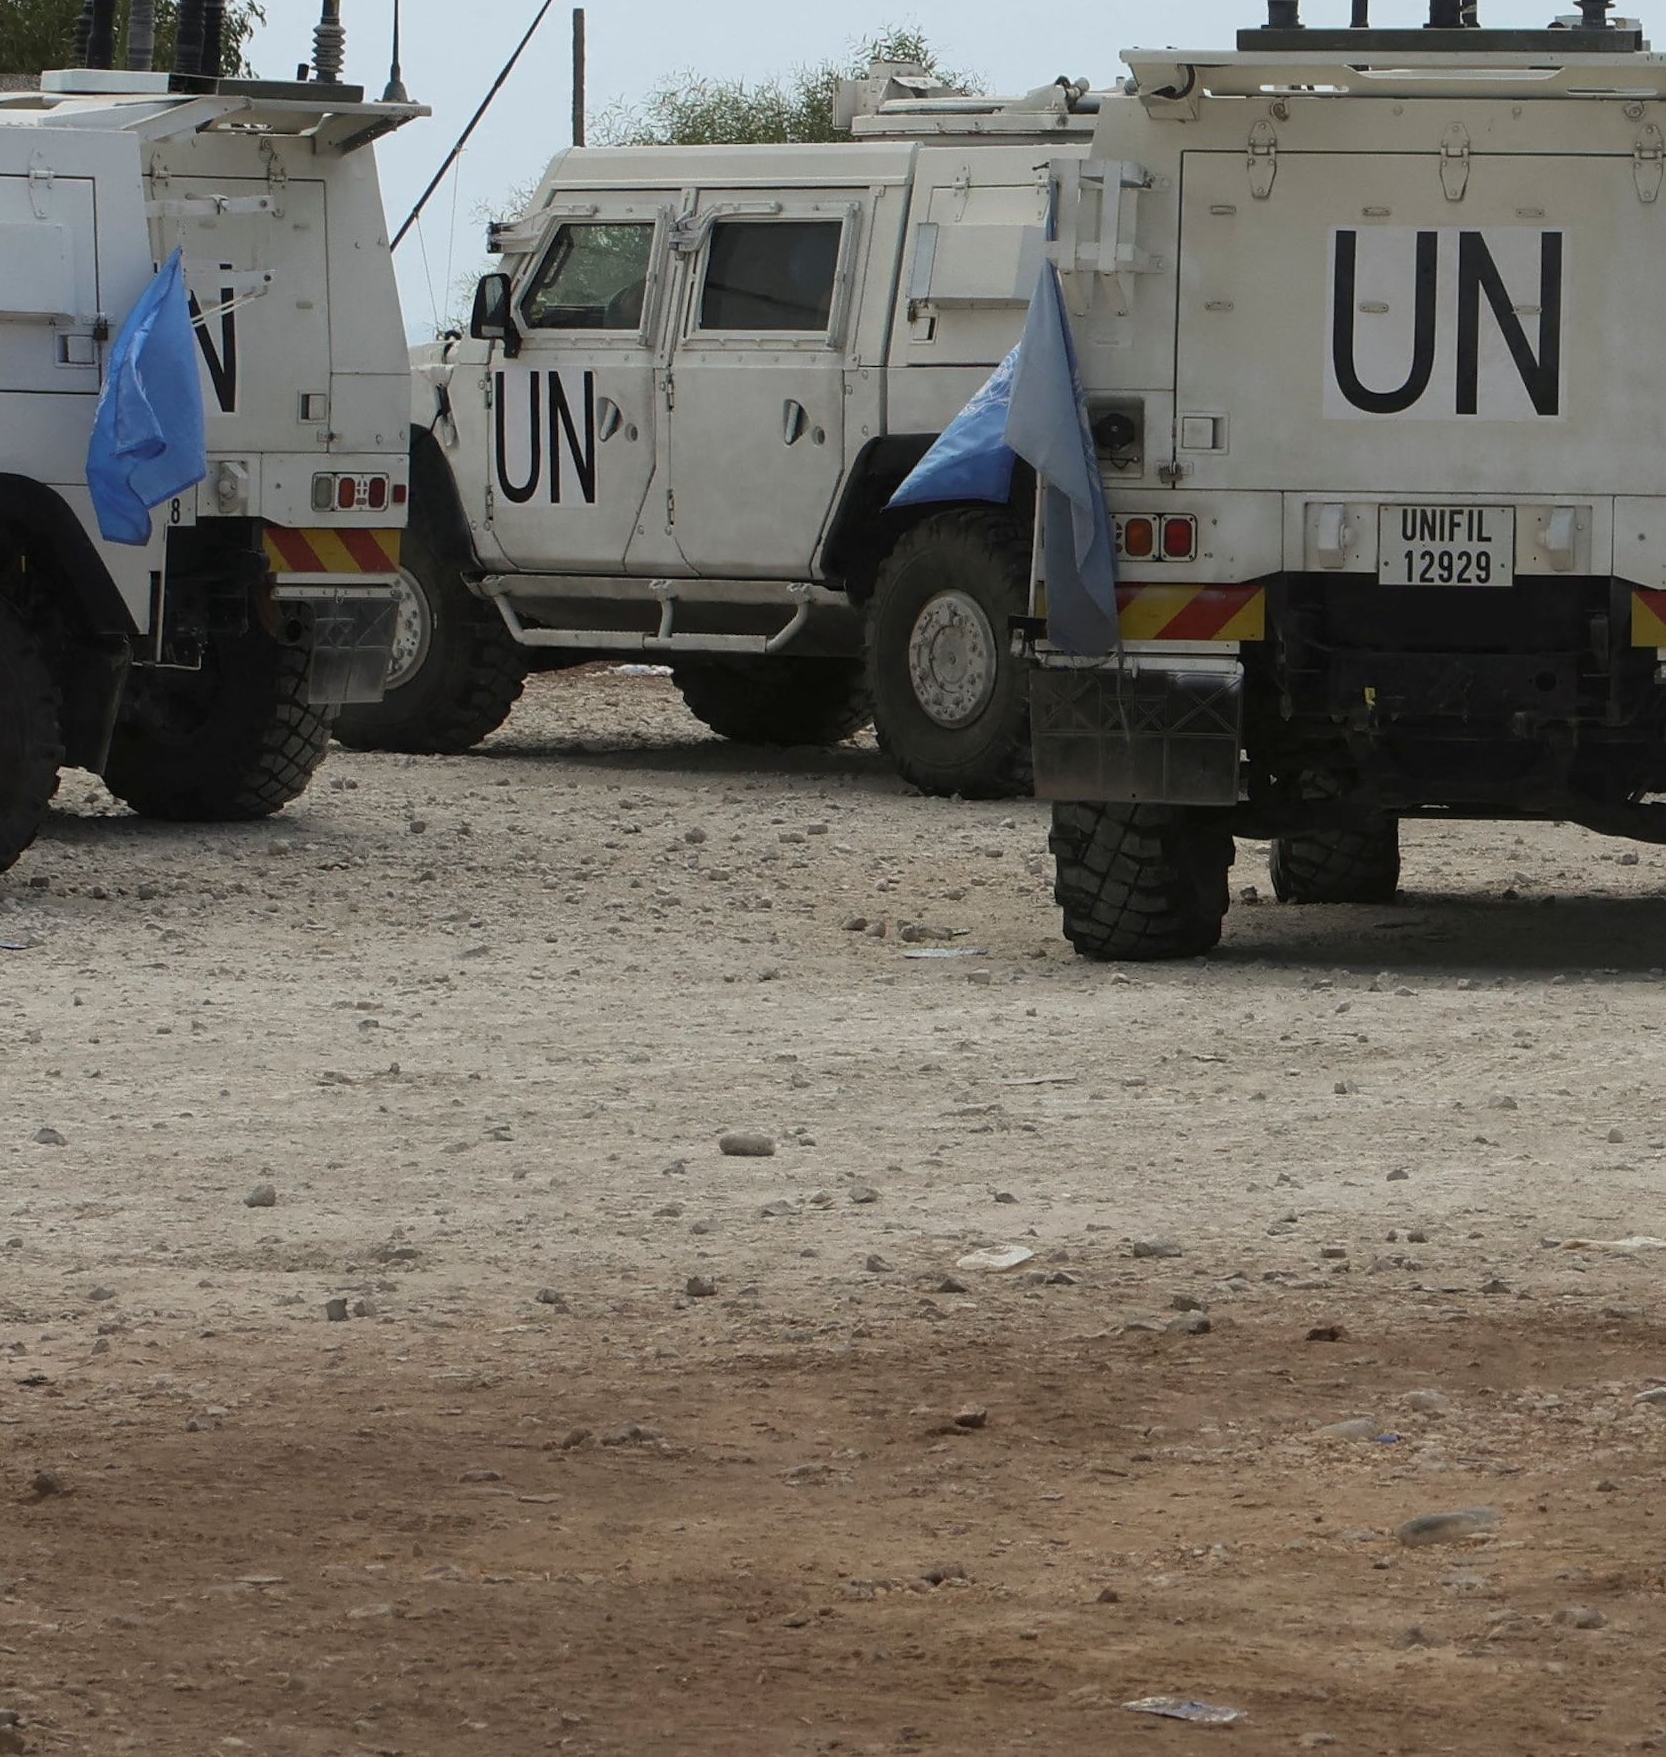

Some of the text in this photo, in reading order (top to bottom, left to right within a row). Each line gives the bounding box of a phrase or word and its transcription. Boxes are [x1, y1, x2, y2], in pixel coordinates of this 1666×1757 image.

[154, 263, 237, 412] N
[1333, 230, 1562, 416] UN
[495, 371, 595, 503] UN
[1401, 508, 1492, 542] UNIFIL
[1404, 550, 1491, 584] 12929
